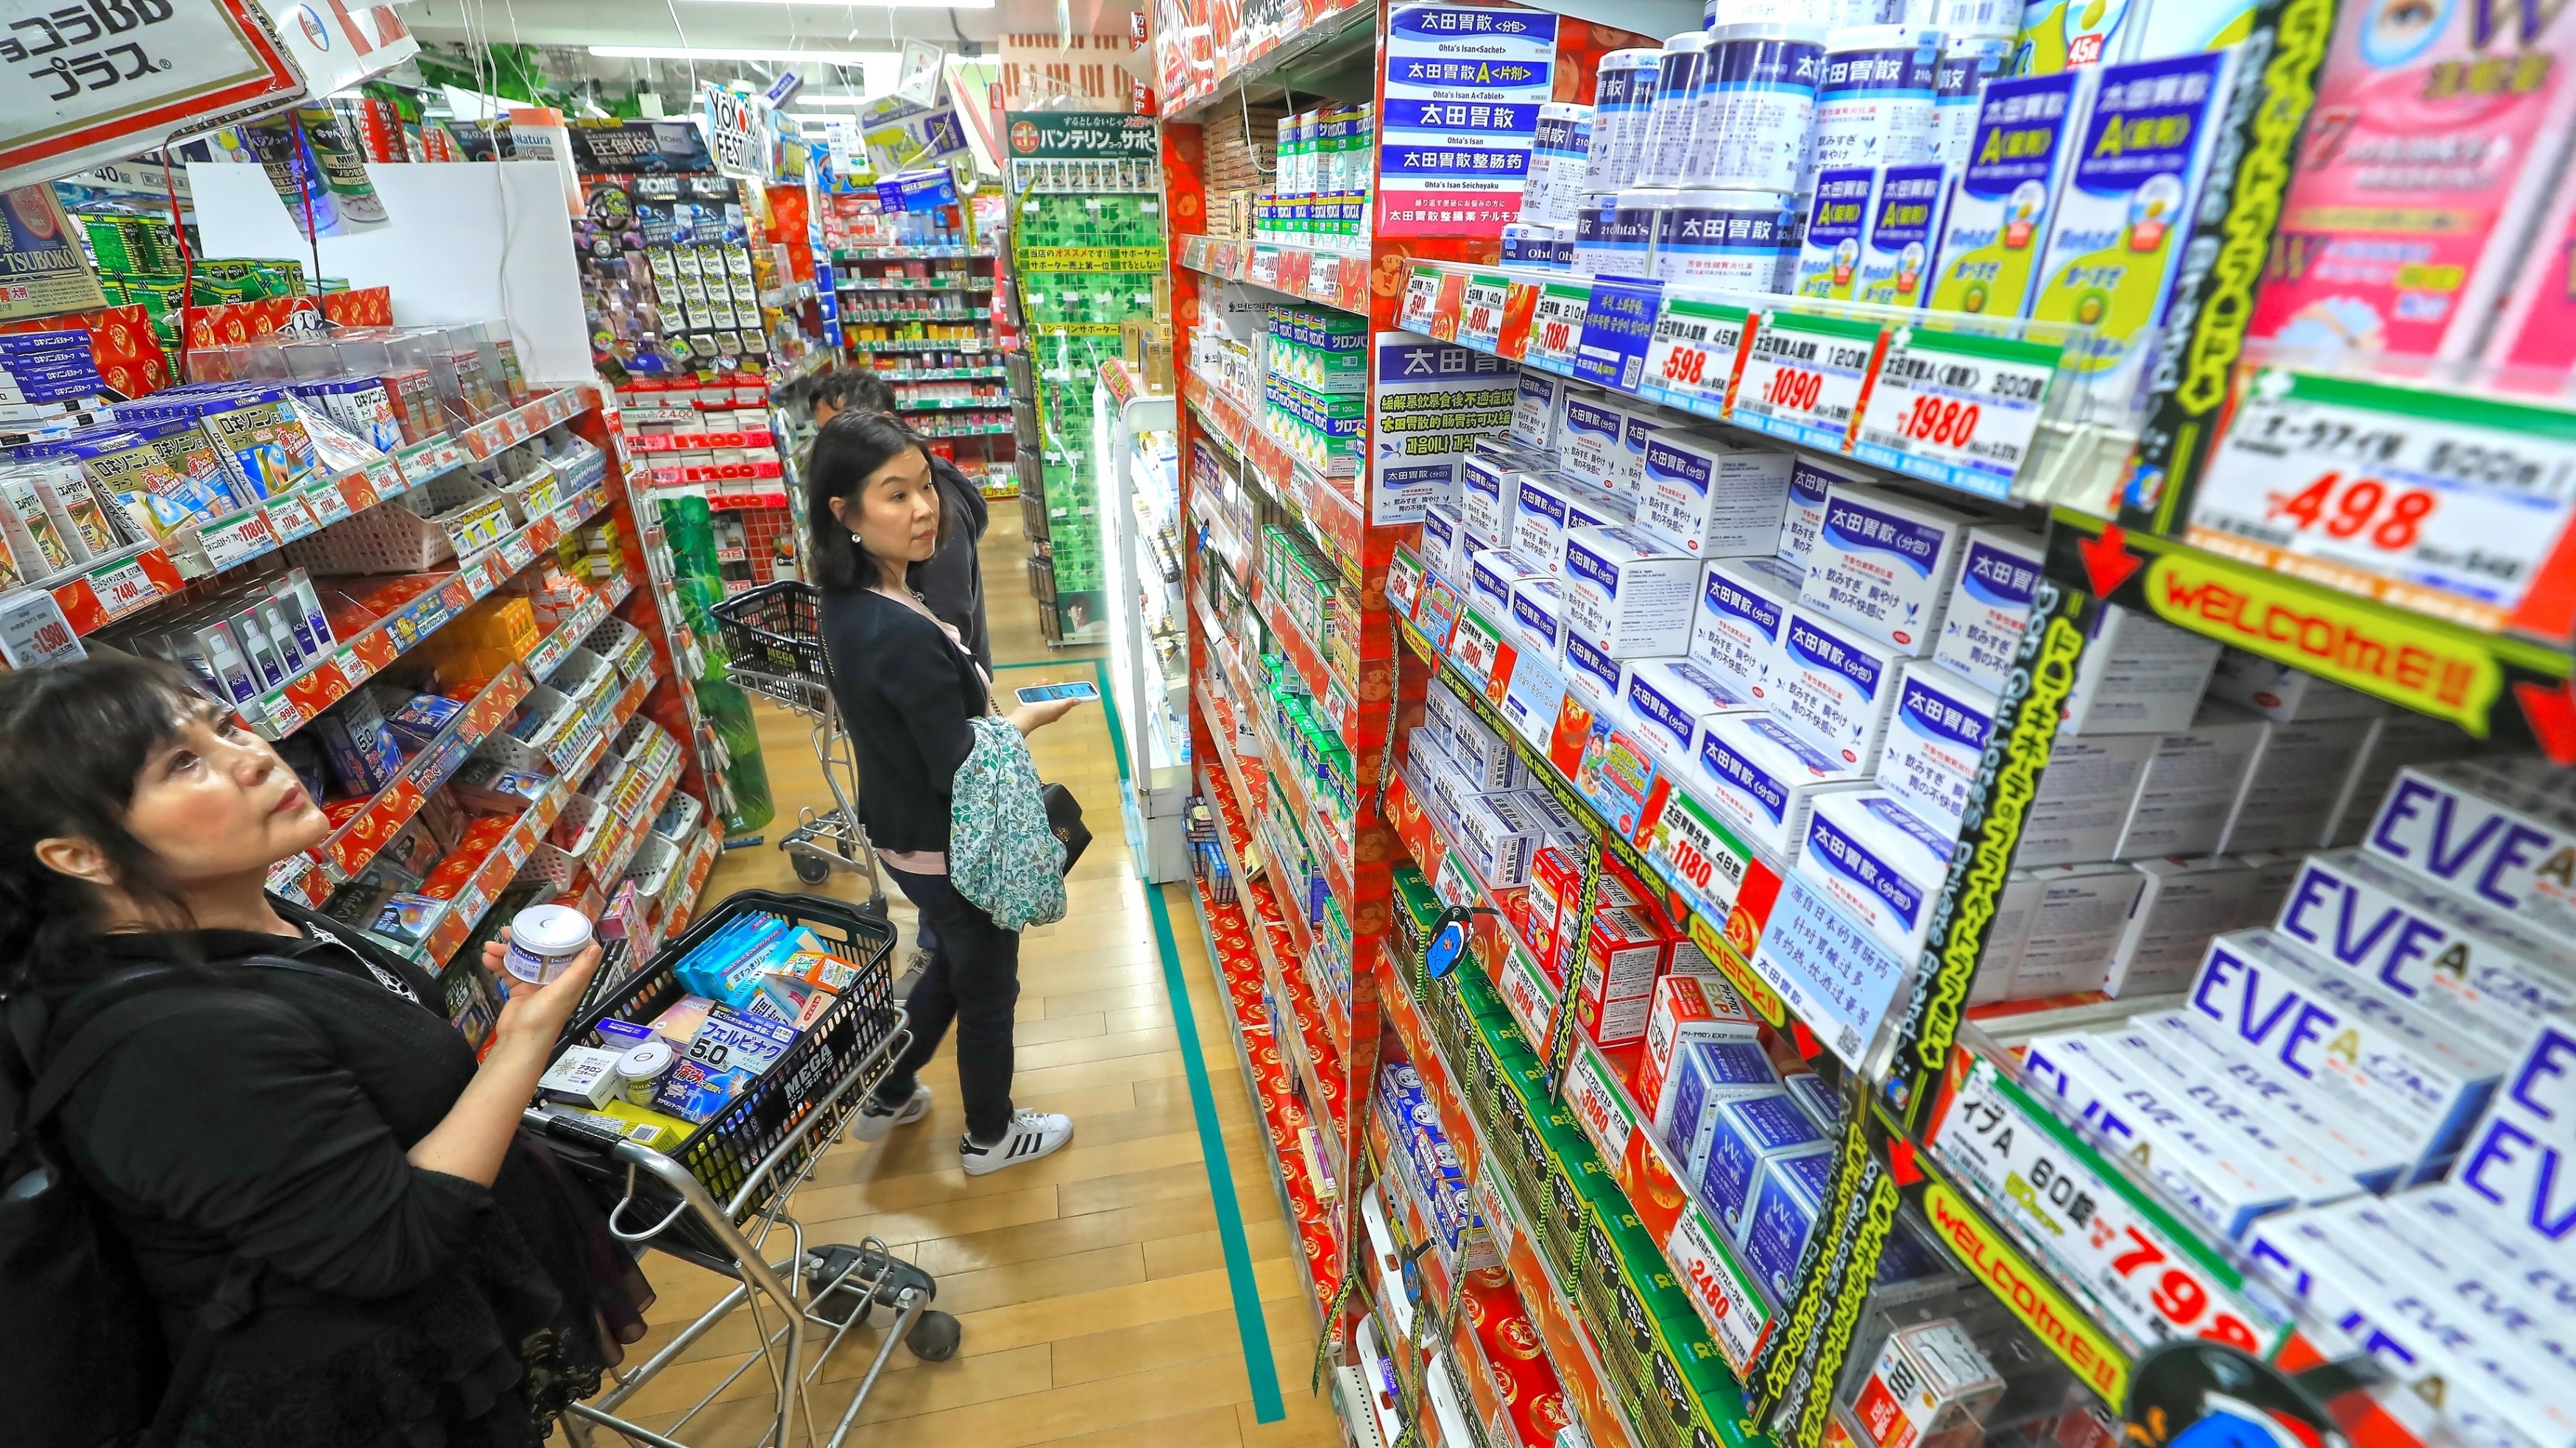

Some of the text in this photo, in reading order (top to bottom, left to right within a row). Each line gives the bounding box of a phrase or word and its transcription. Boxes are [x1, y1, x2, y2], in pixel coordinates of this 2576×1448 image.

[1439, 44, 1459, 53] Ohta's
[1420, 103, 1515, 129] 太田胃散
[1404, 152, 1523, 169] 太田胃散整肠药
[637, 177, 679, 193] ZONE
[690, 177, 729, 193] ZONE
[1389, 210, 1476, 222] 太田胃散整腸薬
[1681, 218, 1773, 240] 太田胃散
[1471, 306, 1490, 332] 880
[1546, 323, 1570, 351] 1180
[1669, 346, 1708, 384] 598
[1770, 366, 1824, 413] 1090
[1905, 392, 1981, 450] 1980
[239, 518, 265, 541] 1180
[2285, 469, 2435, 552] 498
[113, 581, 138, 603] 7480
[1464, 638, 1482, 667] 1080
[2374, 778, 2554, 910] EVE
[1673, 838, 1713, 889] 1180
[2284, 866, 2447, 998] EVE
[1514, 979, 1535, 1018] 1998
[2194, 948, 2340, 1080] EVE
[701, 1021, 785, 1060] フェルビナク
[784, 1043, 833, 1101] MEGA
[1582, 1089, 1609, 1134] 3980
[1691, 1259, 1730, 1319] 2480
